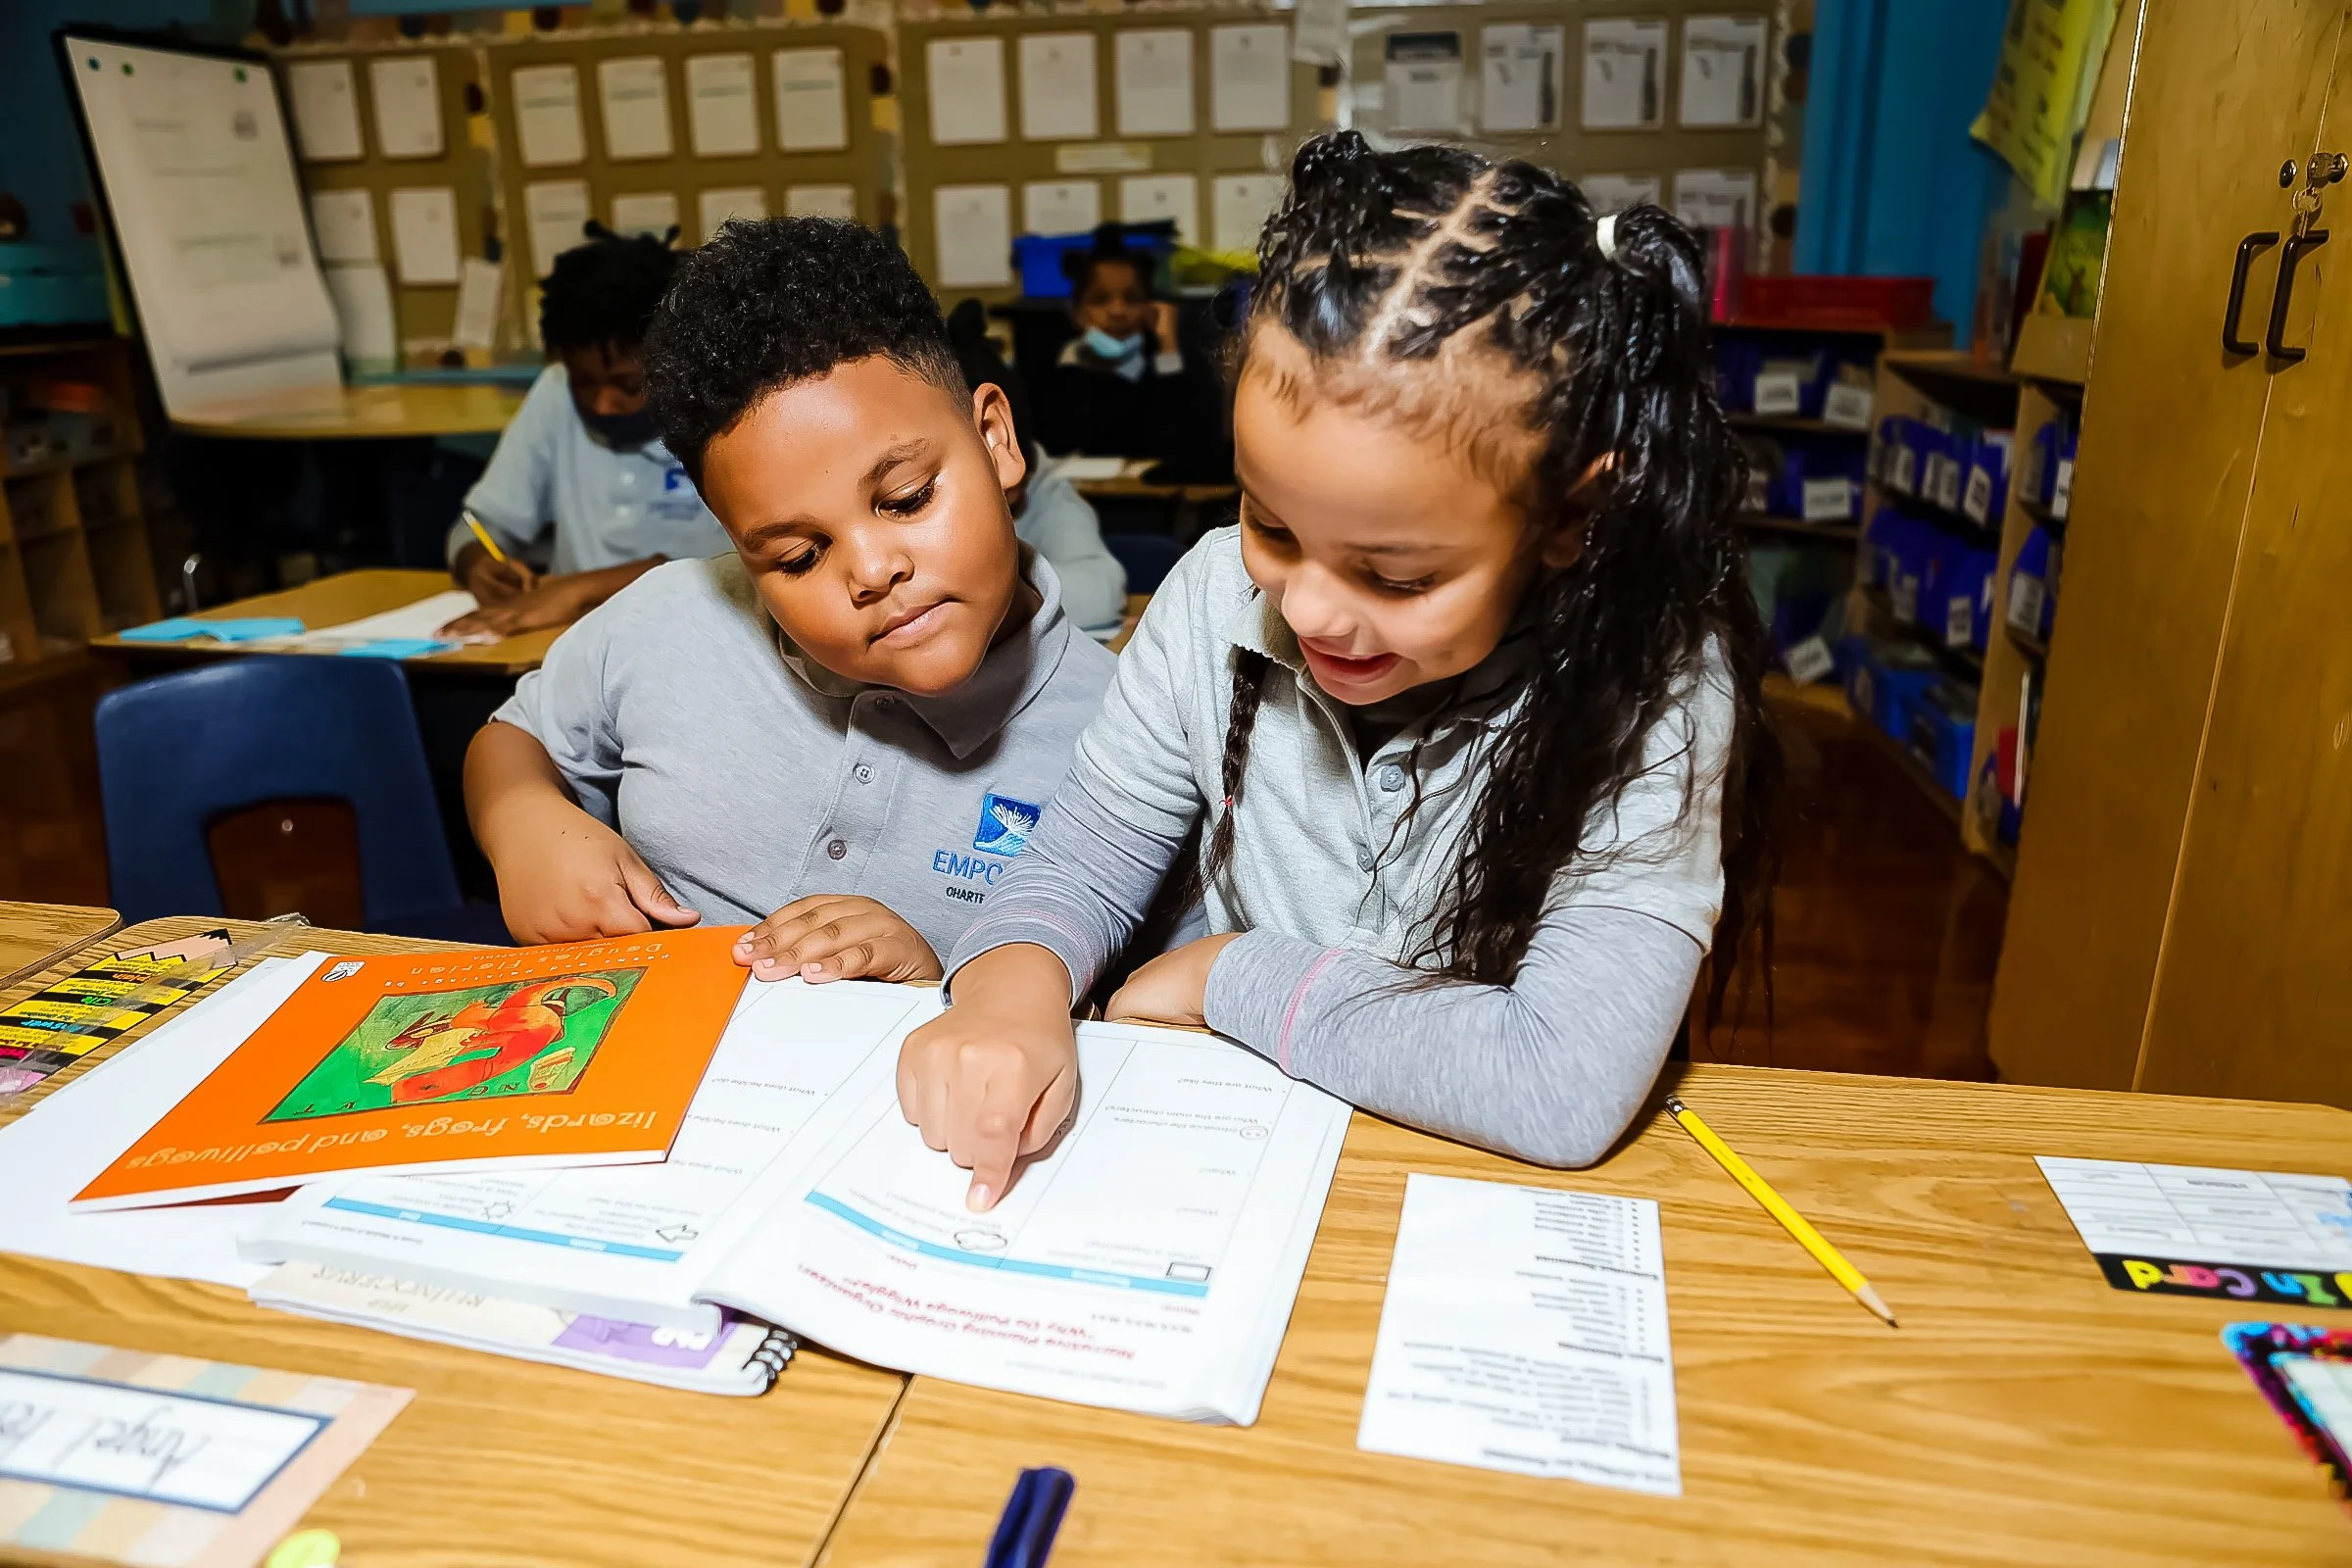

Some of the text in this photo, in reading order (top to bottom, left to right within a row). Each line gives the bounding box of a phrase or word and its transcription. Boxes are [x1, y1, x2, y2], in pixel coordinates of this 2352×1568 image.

[410, 942, 663, 975] Douglas Florian
[1245, 1084, 1272, 1093] What
[124, 1110, 658, 1170] lizards, frogs, and polliwogs
[2122, 1259, 2259, 1298] Card
